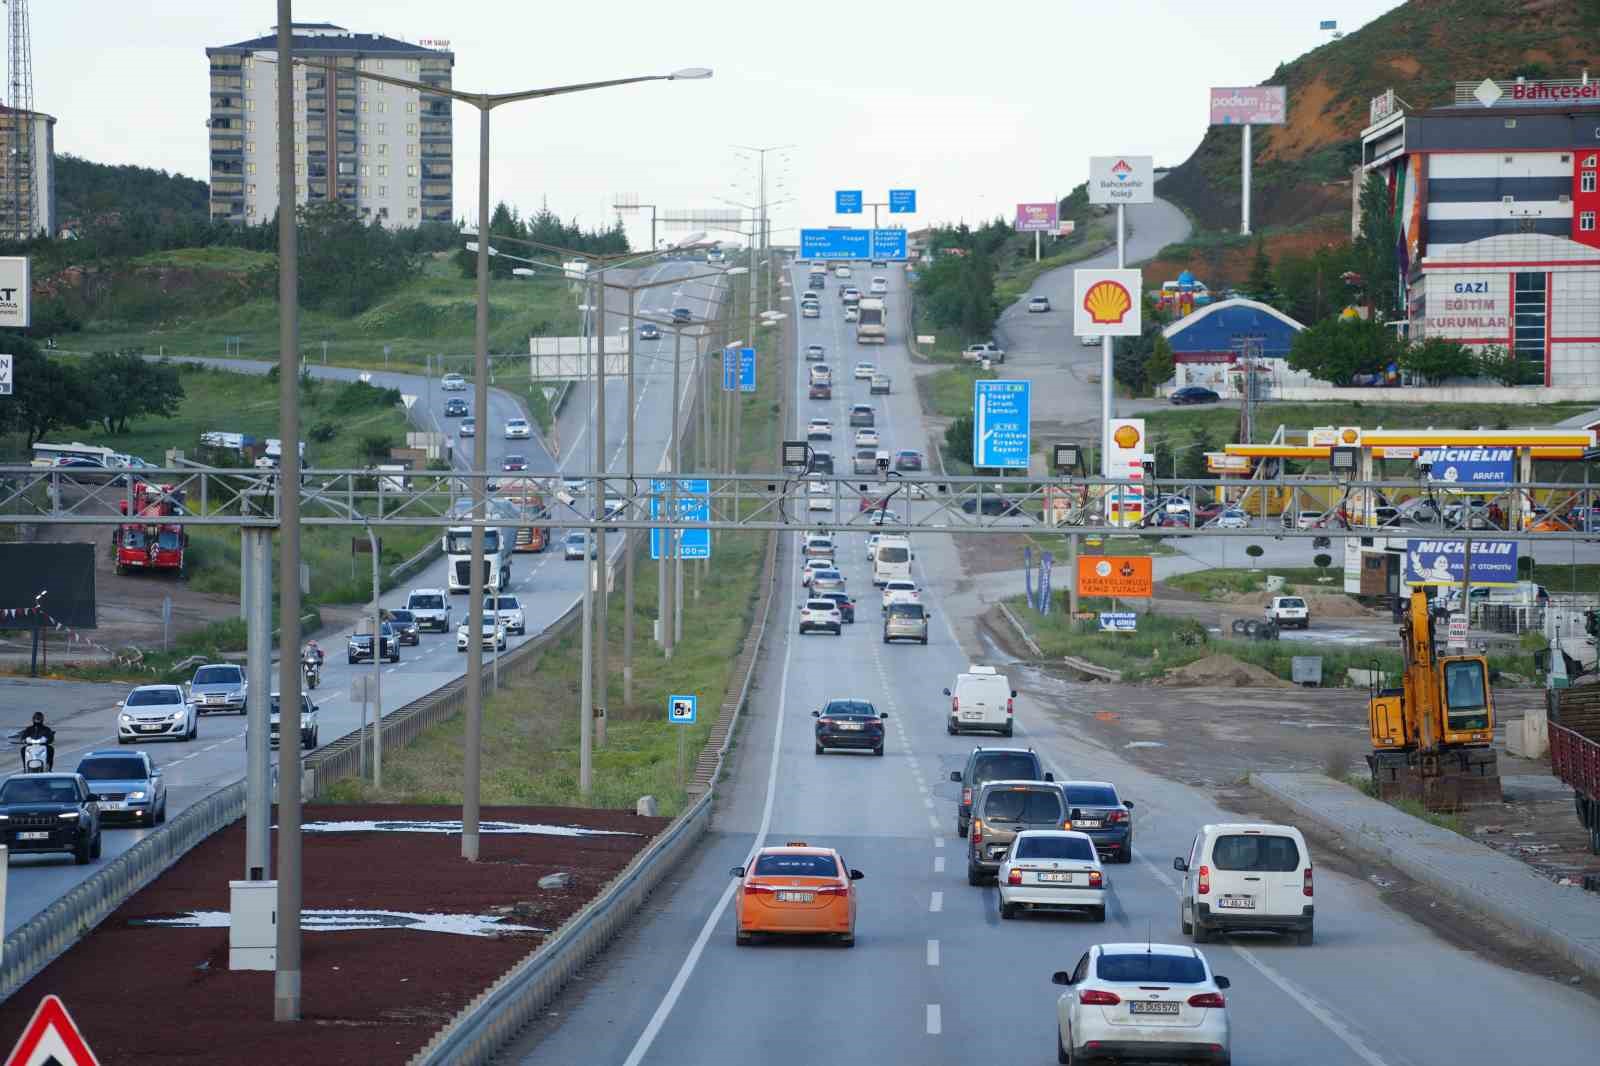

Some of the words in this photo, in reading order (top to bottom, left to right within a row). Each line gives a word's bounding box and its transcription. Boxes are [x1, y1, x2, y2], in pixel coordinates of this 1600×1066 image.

[1454, 280, 1488, 293] GAZİ
[1445, 297, 1495, 311] EĞİTİM
[1421, 450, 1514, 462] MICHELIN
[1417, 542, 1513, 554] MICHELIN
